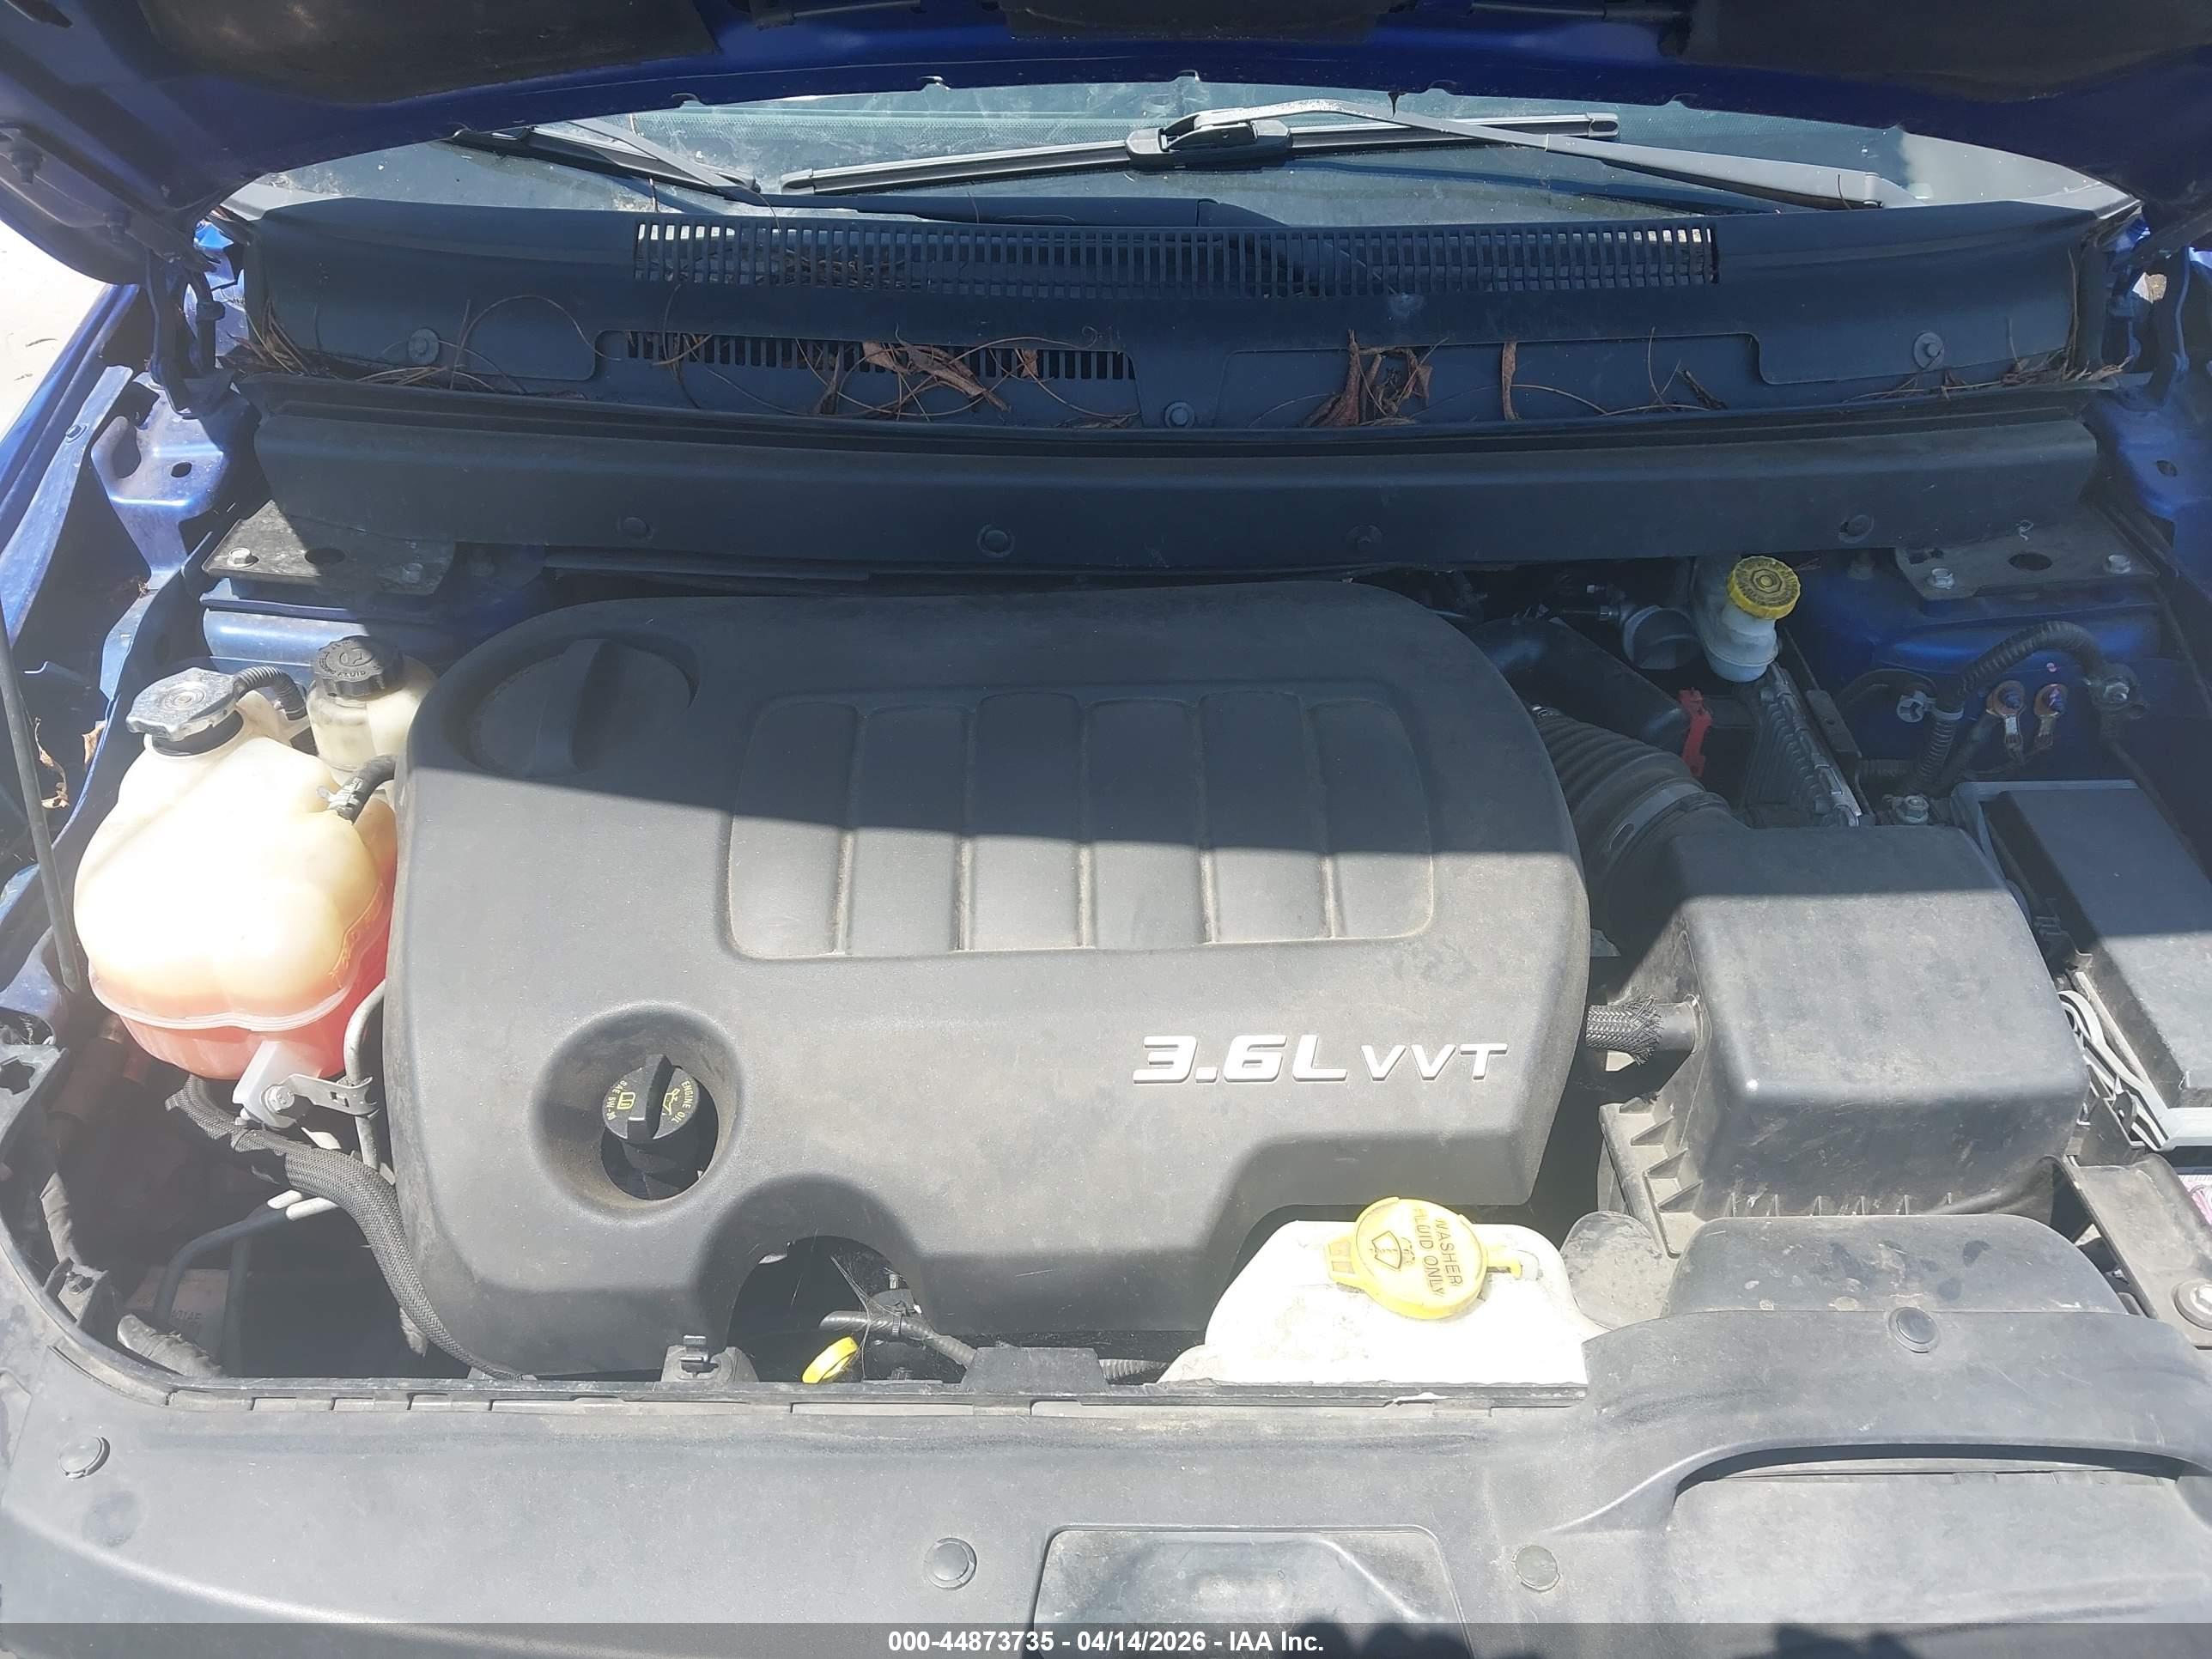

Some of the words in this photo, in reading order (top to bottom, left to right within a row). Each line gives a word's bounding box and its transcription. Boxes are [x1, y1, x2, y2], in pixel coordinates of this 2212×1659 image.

[1133, 1035, 1347, 1084] 3.6L
[1361, 1042, 1509, 1081] VVT
[611, 1080, 628, 1095] SAE
[681, 1080, 694, 1109] ENGINE
[671, 1111, 686, 1123] OIL
[1413, 1208, 1434, 1249] FLUID
[1435, 1218, 1463, 1287] WASHER
[1423, 1255, 1445, 1297] ONLY
